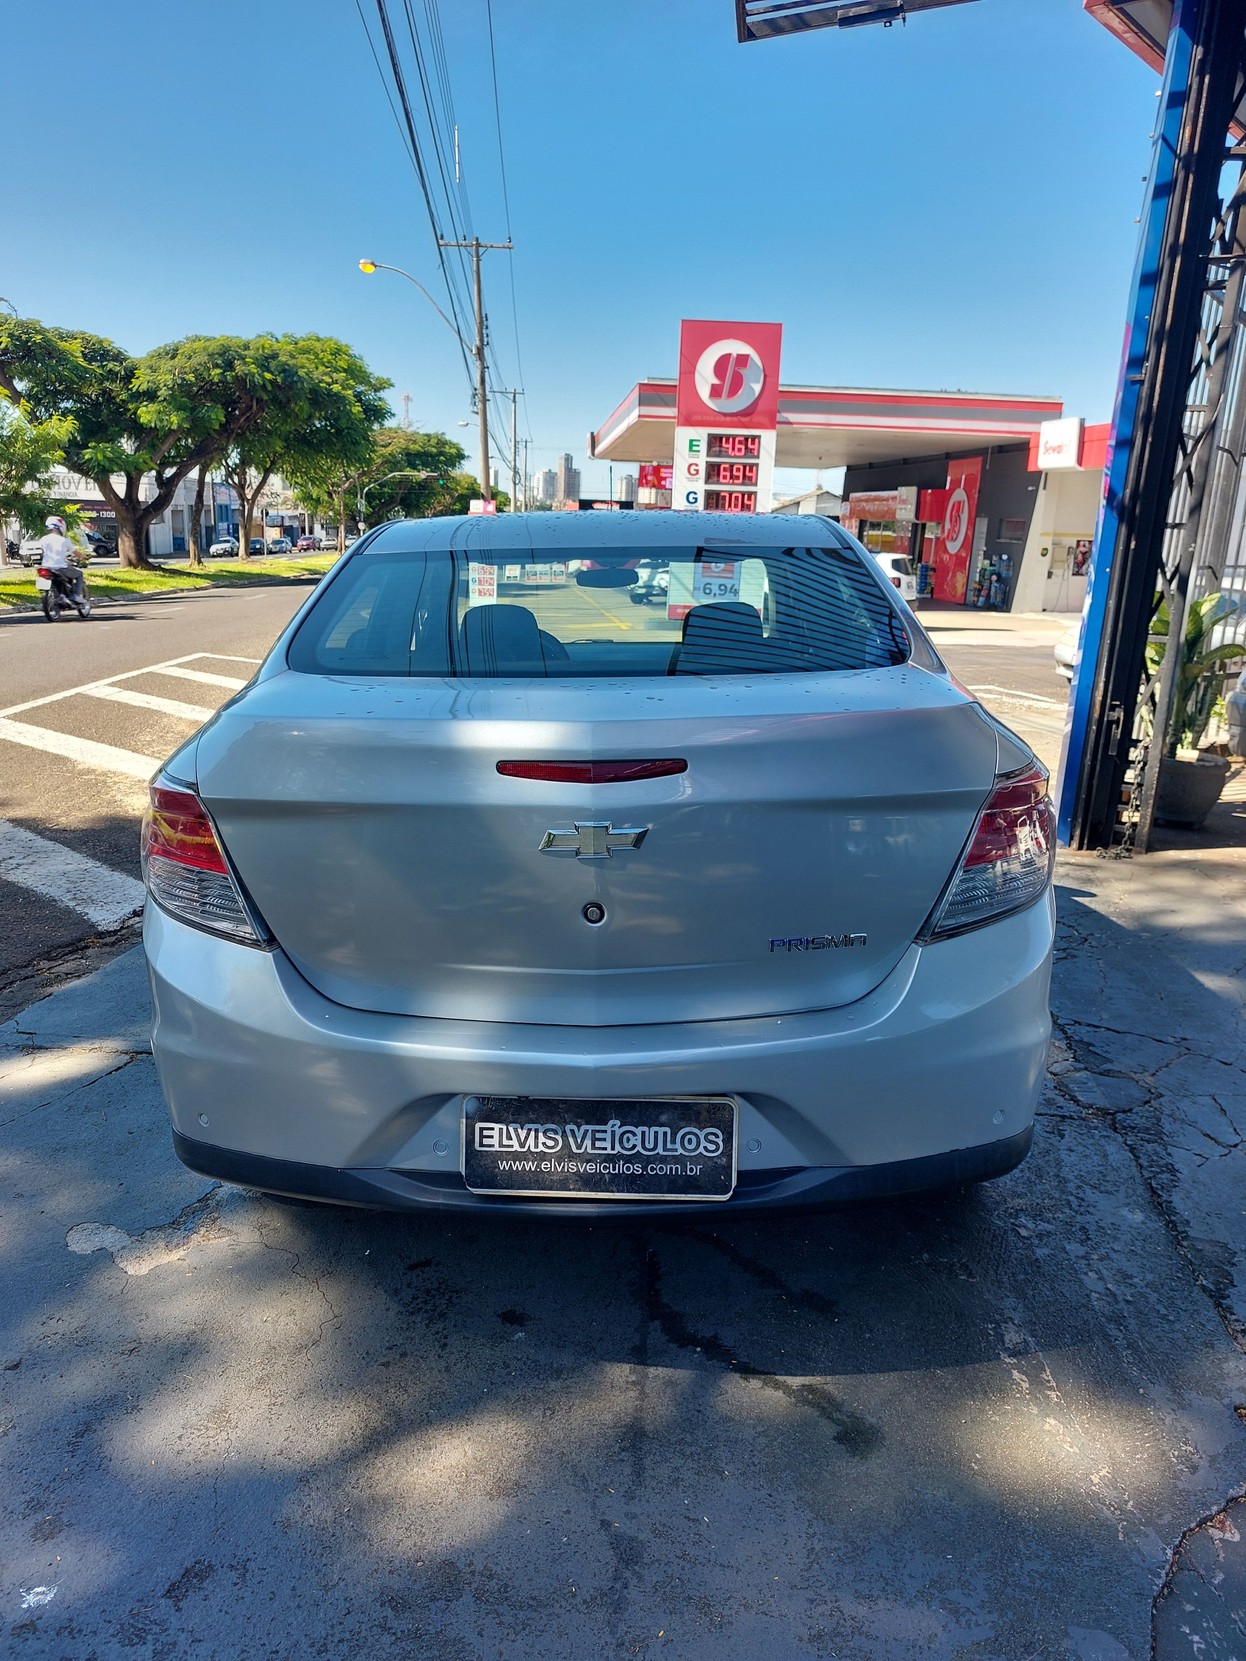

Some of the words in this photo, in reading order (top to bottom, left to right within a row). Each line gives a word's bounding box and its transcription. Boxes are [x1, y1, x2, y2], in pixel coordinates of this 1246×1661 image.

[689, 439, 701, 453] E
[722, 436, 759, 456] 4,64
[687, 463, 699, 476] G
[720, 464, 756, 484] 6,94
[686, 491, 698, 504] G
[720, 492, 755, 512] 7,04
[702, 582, 739, 598] 6,94
[769, 933, 868, 953] PRISMA
[475, 1122, 563, 1152] ELVIS
[565, 1119, 724, 1157] VEÍCULOS
[498, 1159, 703, 1176] www.elvisveiculos.com.br
